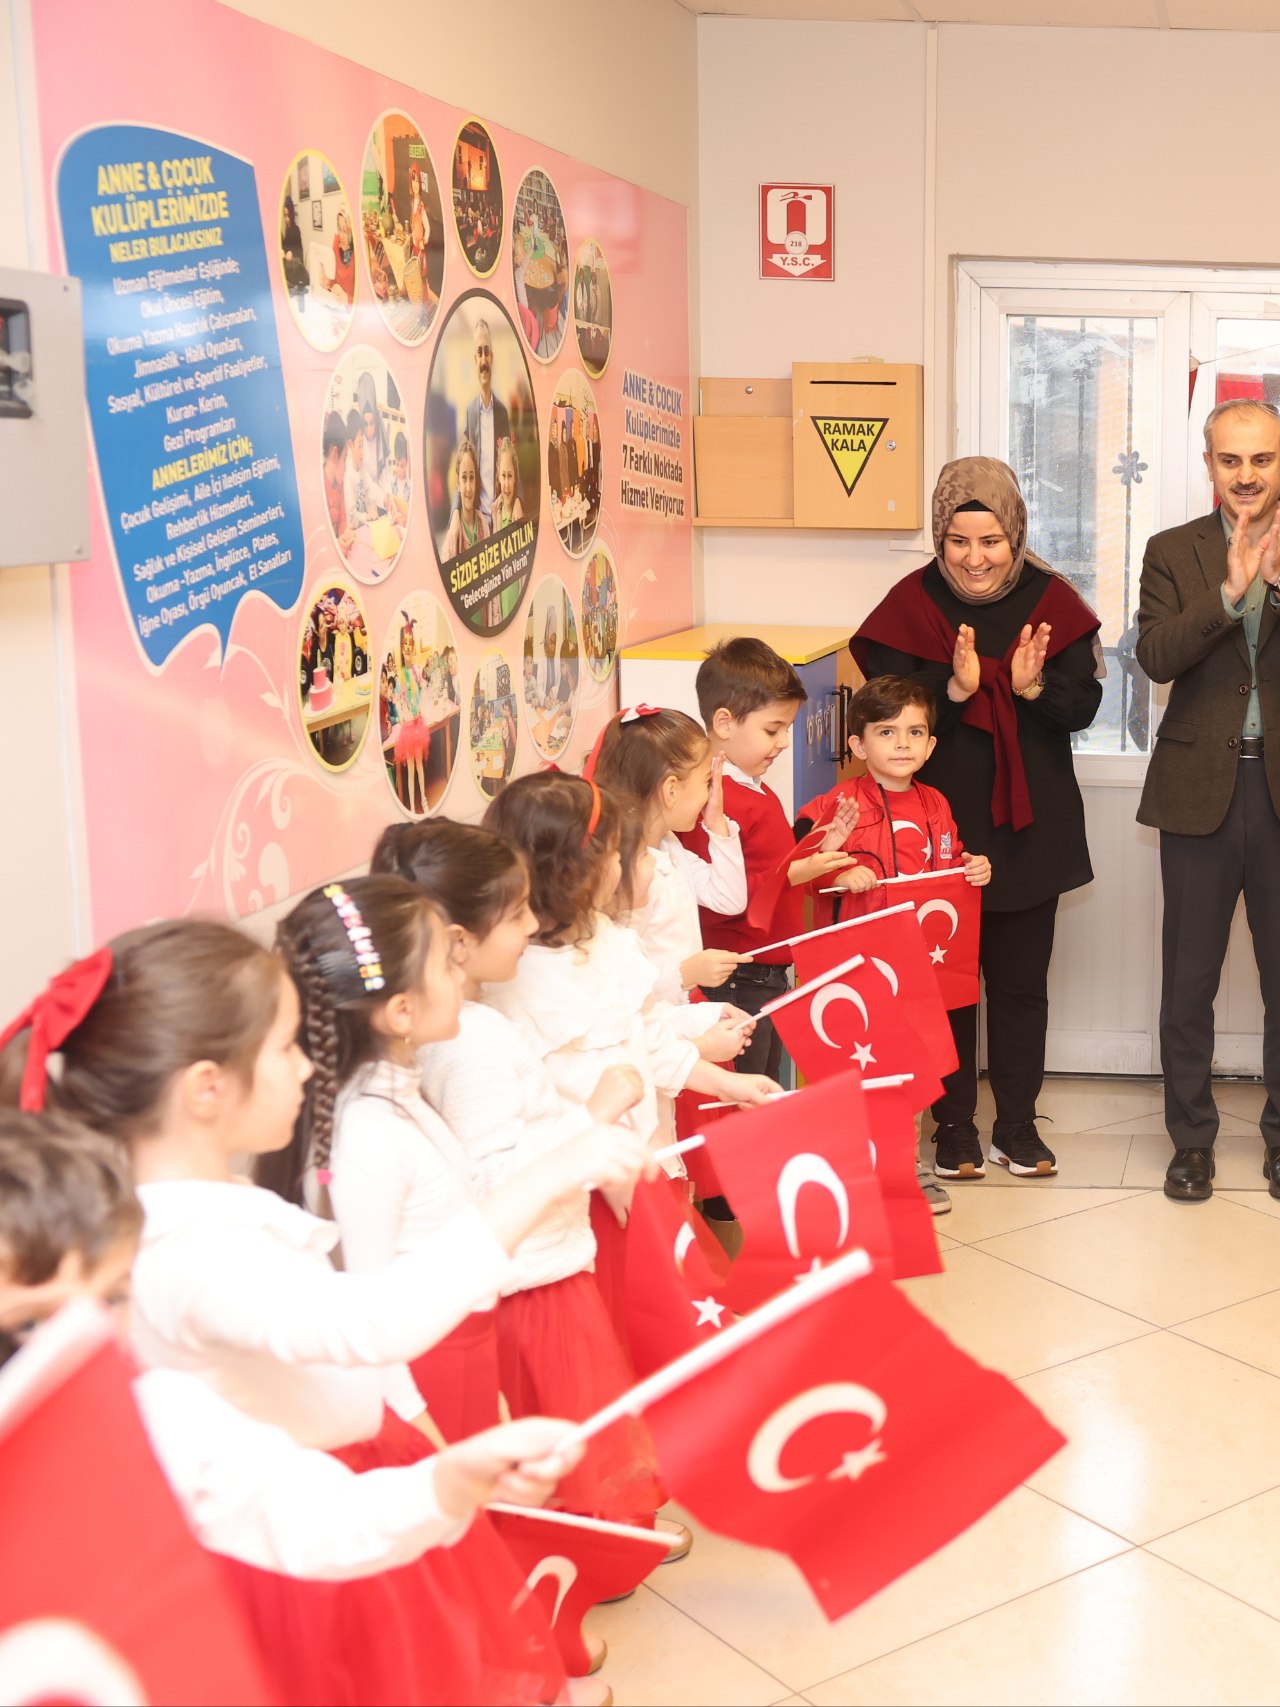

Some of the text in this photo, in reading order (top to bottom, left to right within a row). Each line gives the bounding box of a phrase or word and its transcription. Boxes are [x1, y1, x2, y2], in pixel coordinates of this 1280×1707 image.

[98, 157, 214, 194] ANNE & ÇOCUK
[92, 189, 229, 235] KULÜPLERİMİZDE
[110, 228, 223, 262] NELER BULACAKSINIZ
[779, 256, 815, 267] Y.S.C.
[790, 240, 802, 248] 218
[114, 277, 147, 294] Uzman
[149, 266, 197, 290] Eğitmenler
[108, 337, 143, 354] Okuma
[135, 352, 179, 377] Jimnastik
[185, 345, 206, 363] Halk
[207, 338, 242, 359] Oyunları,
[108, 389, 144, 412] Sosyal,
[145, 377, 183, 401] Kültürel
[184, 378, 194, 390] ve
[195, 365, 223, 389] Sportif
[623, 371, 682, 416] ANNE & ÇOCUK
[167, 394, 228, 423] Kuran- Kerim,
[164, 418, 235, 451] Gezi Programları
[625, 409, 681, 449] Kulüplerimizle
[823, 422, 875, 436] RAMAK
[831, 438, 867, 452] KALA
[153, 435, 253, 489] ANNELERİMİZ İÇİN;
[622, 444, 683, 483] 7 Farklı Noktada
[121, 505, 152, 533] Çocuk
[152, 490, 192, 514] Gelişimi,
[195, 483, 211, 501] Aile
[211, 475, 221, 496] İçi
[252, 454, 281, 478] Eğitimi,
[621, 480, 684, 518] Hizmet Veriyoruz
[167, 491, 253, 539] Rehberlik Hizmetleri,
[134, 502, 284, 581] Sağlık ve Kişisel Gelişim Seminerleri,
[450, 521, 534, 593] SİZDE BİZE KATILIN
[147, 580, 181, 602] Okuma
[215, 547, 250, 571] İngilizce,
[501, 563, 512, 582] Yön
[139, 551, 291, 637] İğne Oyası, Örgü Oyuncak, El Sanatları
